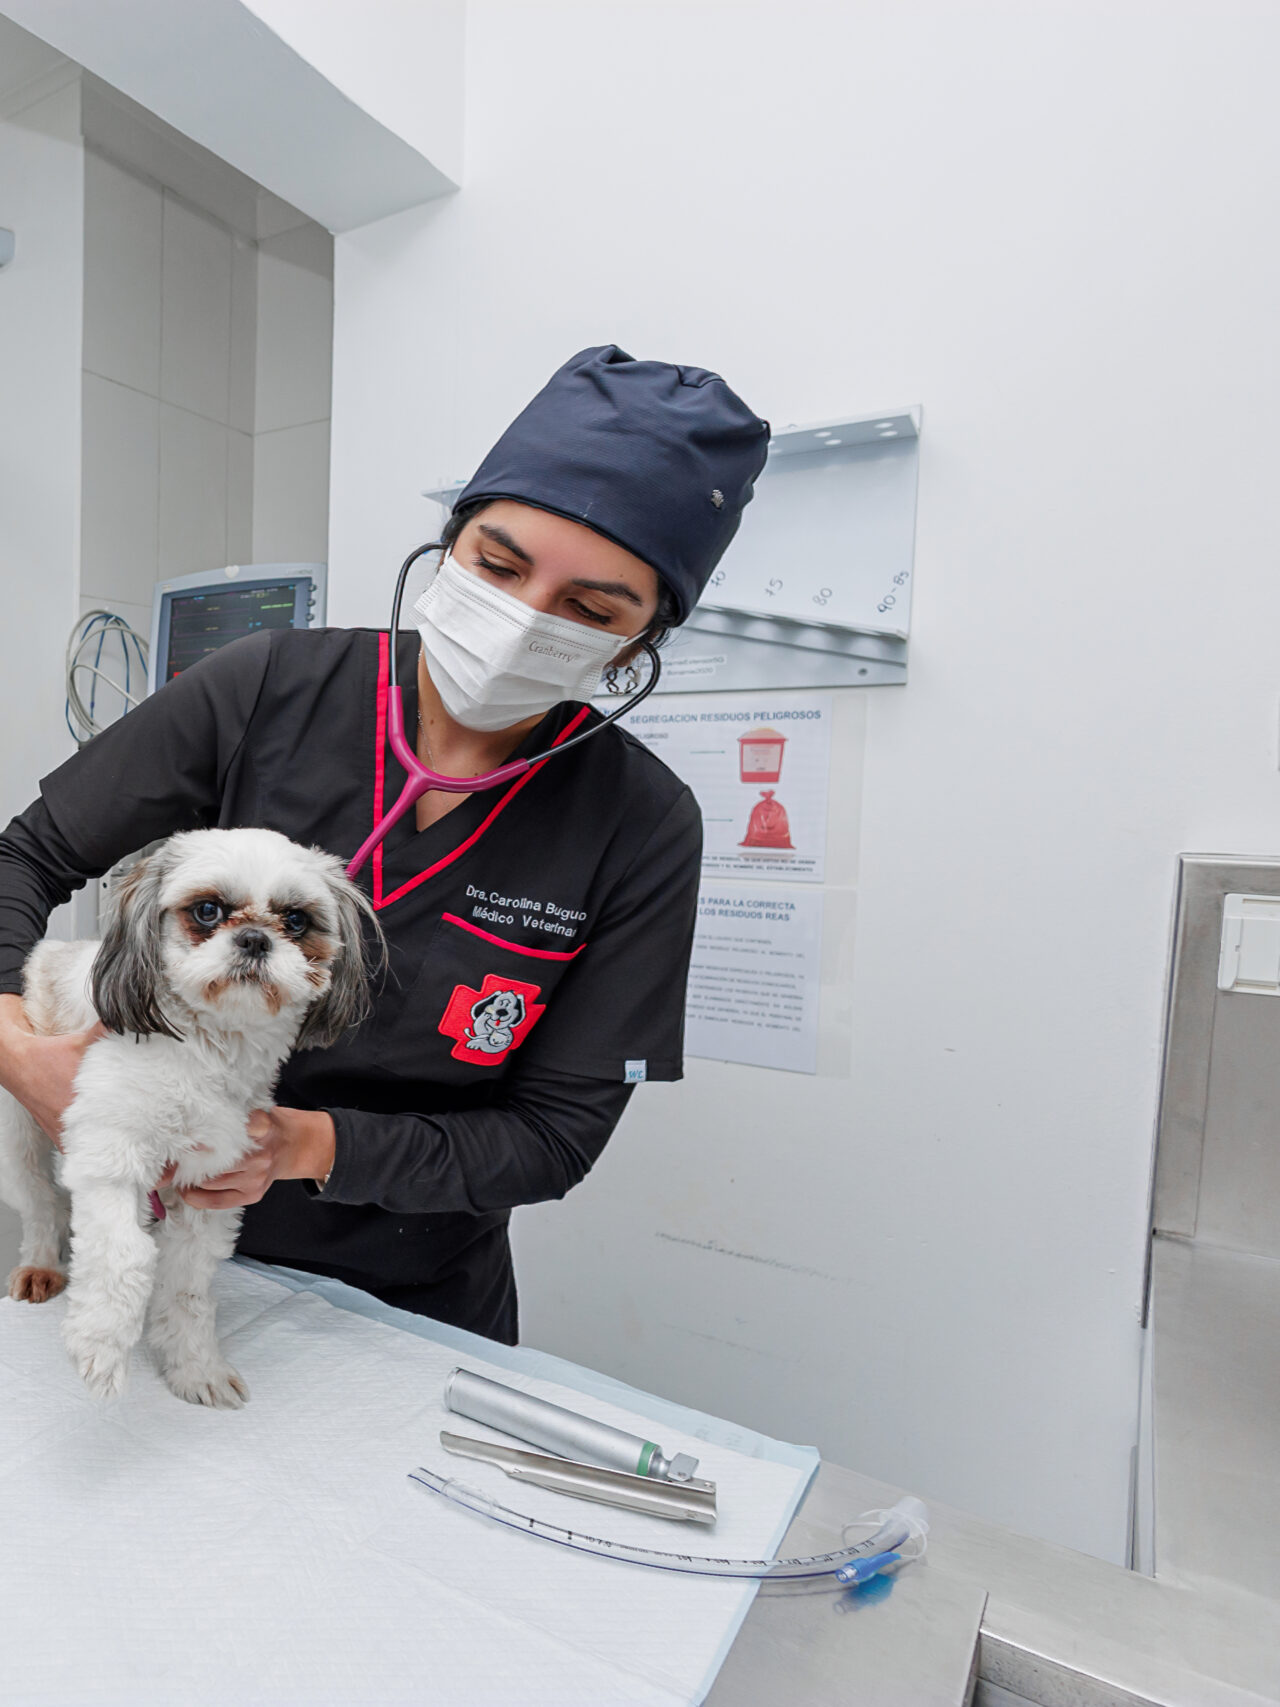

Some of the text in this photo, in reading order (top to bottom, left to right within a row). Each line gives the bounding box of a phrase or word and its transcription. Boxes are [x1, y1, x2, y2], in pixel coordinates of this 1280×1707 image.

[813, 588, 833, 606] 80
[700, 712, 750, 723] RESIDUOS
[753, 710, 821, 721] PELIGROSOS
[708, 897, 731, 907] PARA
[733, 899, 745, 908] LA
[746, 899, 796, 911] CORRECTA
[472, 905, 514, 925] Médico
[699, 908, 790, 922] LOS RESIDUOS REAS
